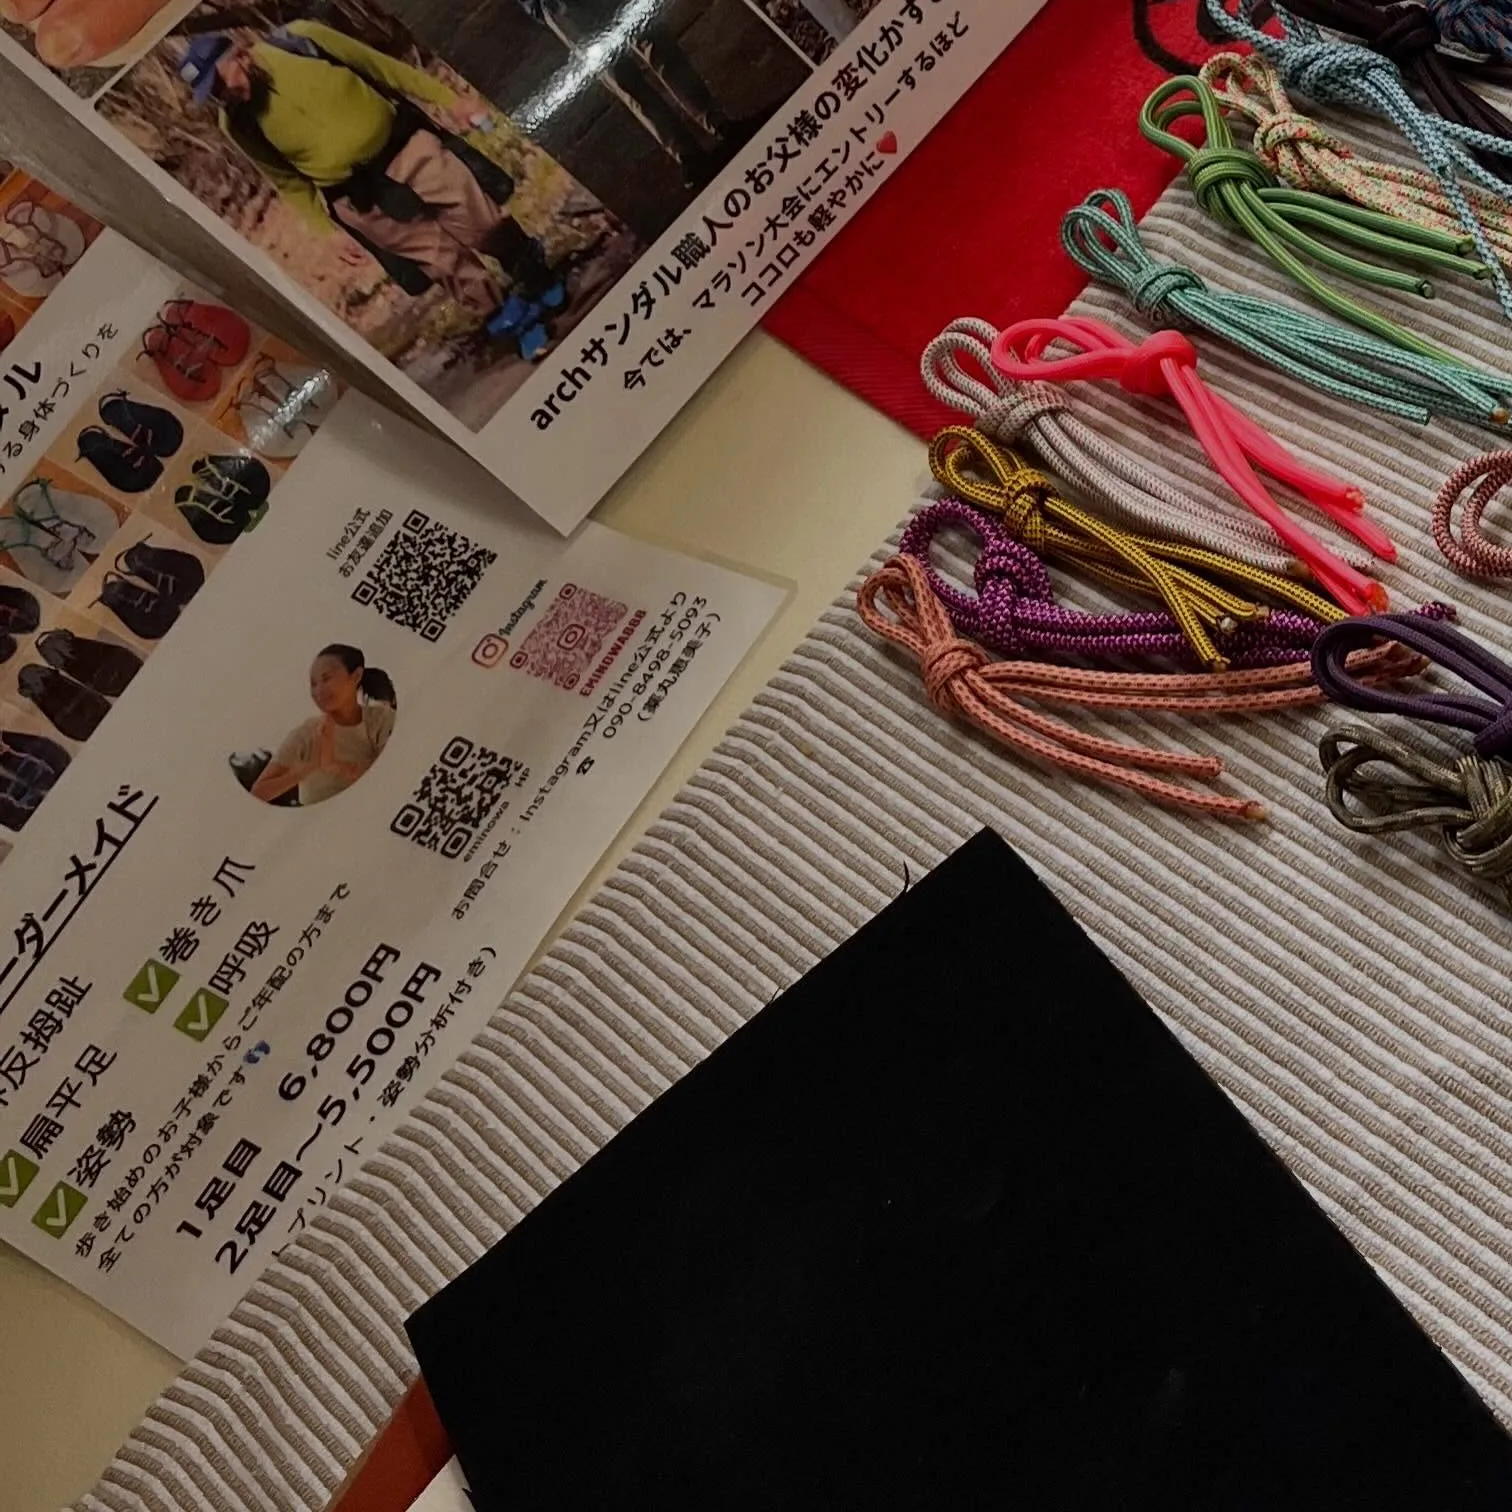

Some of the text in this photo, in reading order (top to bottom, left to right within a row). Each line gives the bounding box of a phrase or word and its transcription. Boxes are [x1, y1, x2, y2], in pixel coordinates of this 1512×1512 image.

[741, 150, 884, 308] ココロも軽やかに
[0, 361, 41, 431] ル
[0, 323, 119, 474] る身体づくりを
[326, 507, 370, 561] line公式
[338, 509, 393, 579] お友達追加
[498, 578, 548, 639] Instagram
[602, 597, 708, 739] 090-8498-5093
[463, 767, 532, 862] eminowa HP
[158, 854, 257, 967] 巻き爪
[208, 919, 281, 996] 呼吸
[0, 975, 94, 1107] 反拇趾
[74, 881, 353, 1259] 歩き始めのお子様からご年配の方まで
[177, 942, 402, 1240] 1足目 6,800円
[19, 1044, 118, 1160] 扁平足
[67, 1109, 137, 1189] 姿勢
[98, 1060, 247, 1274] 全ての方が対象です
